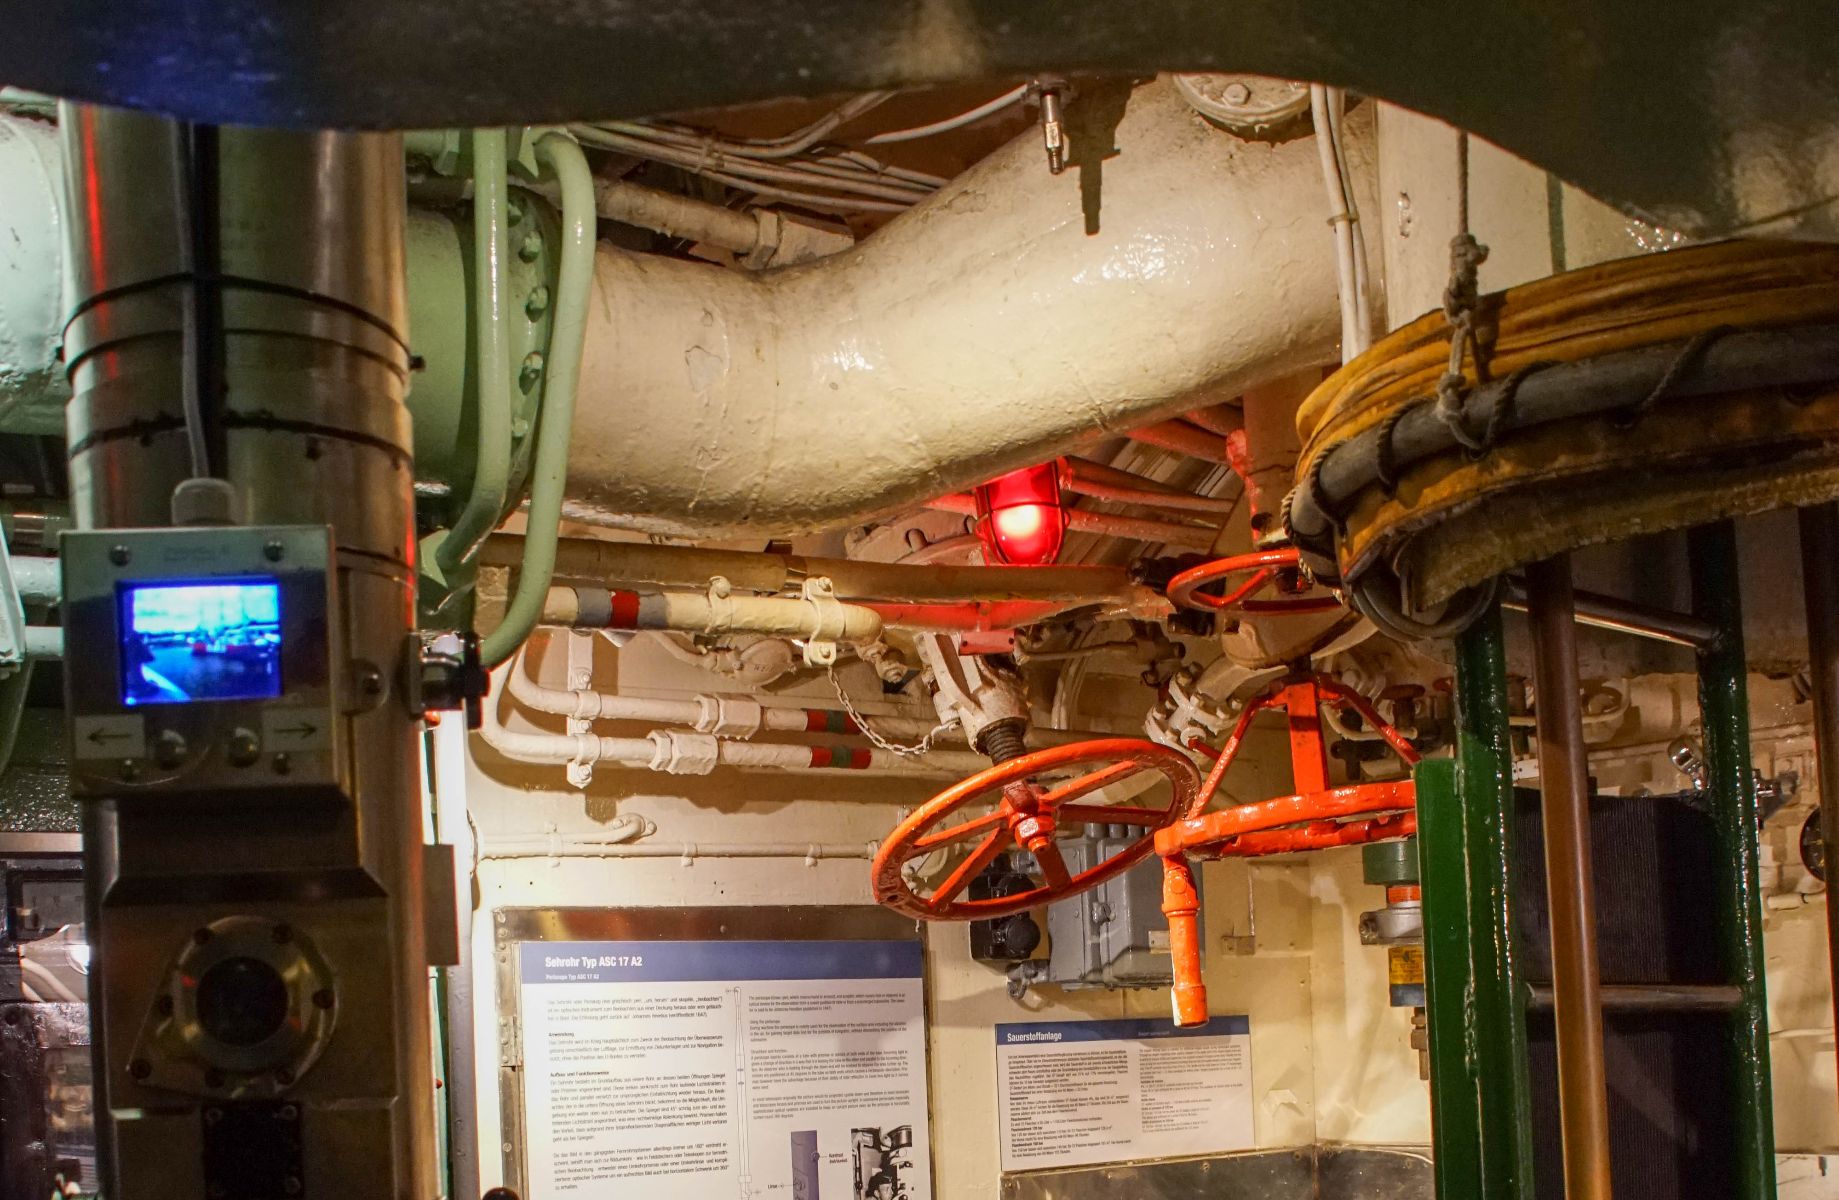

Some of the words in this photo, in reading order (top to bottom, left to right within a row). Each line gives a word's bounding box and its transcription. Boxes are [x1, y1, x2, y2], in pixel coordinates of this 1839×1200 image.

[545, 956, 580, 967] Sehrohr
[581, 956, 597, 968] Typ
[599, 956, 616, 967] ASC
[618, 956, 629, 967] 17
[631, 956, 643, 967] A2
[1007, 1032, 1062, 1042] Sauerstoffanlage
